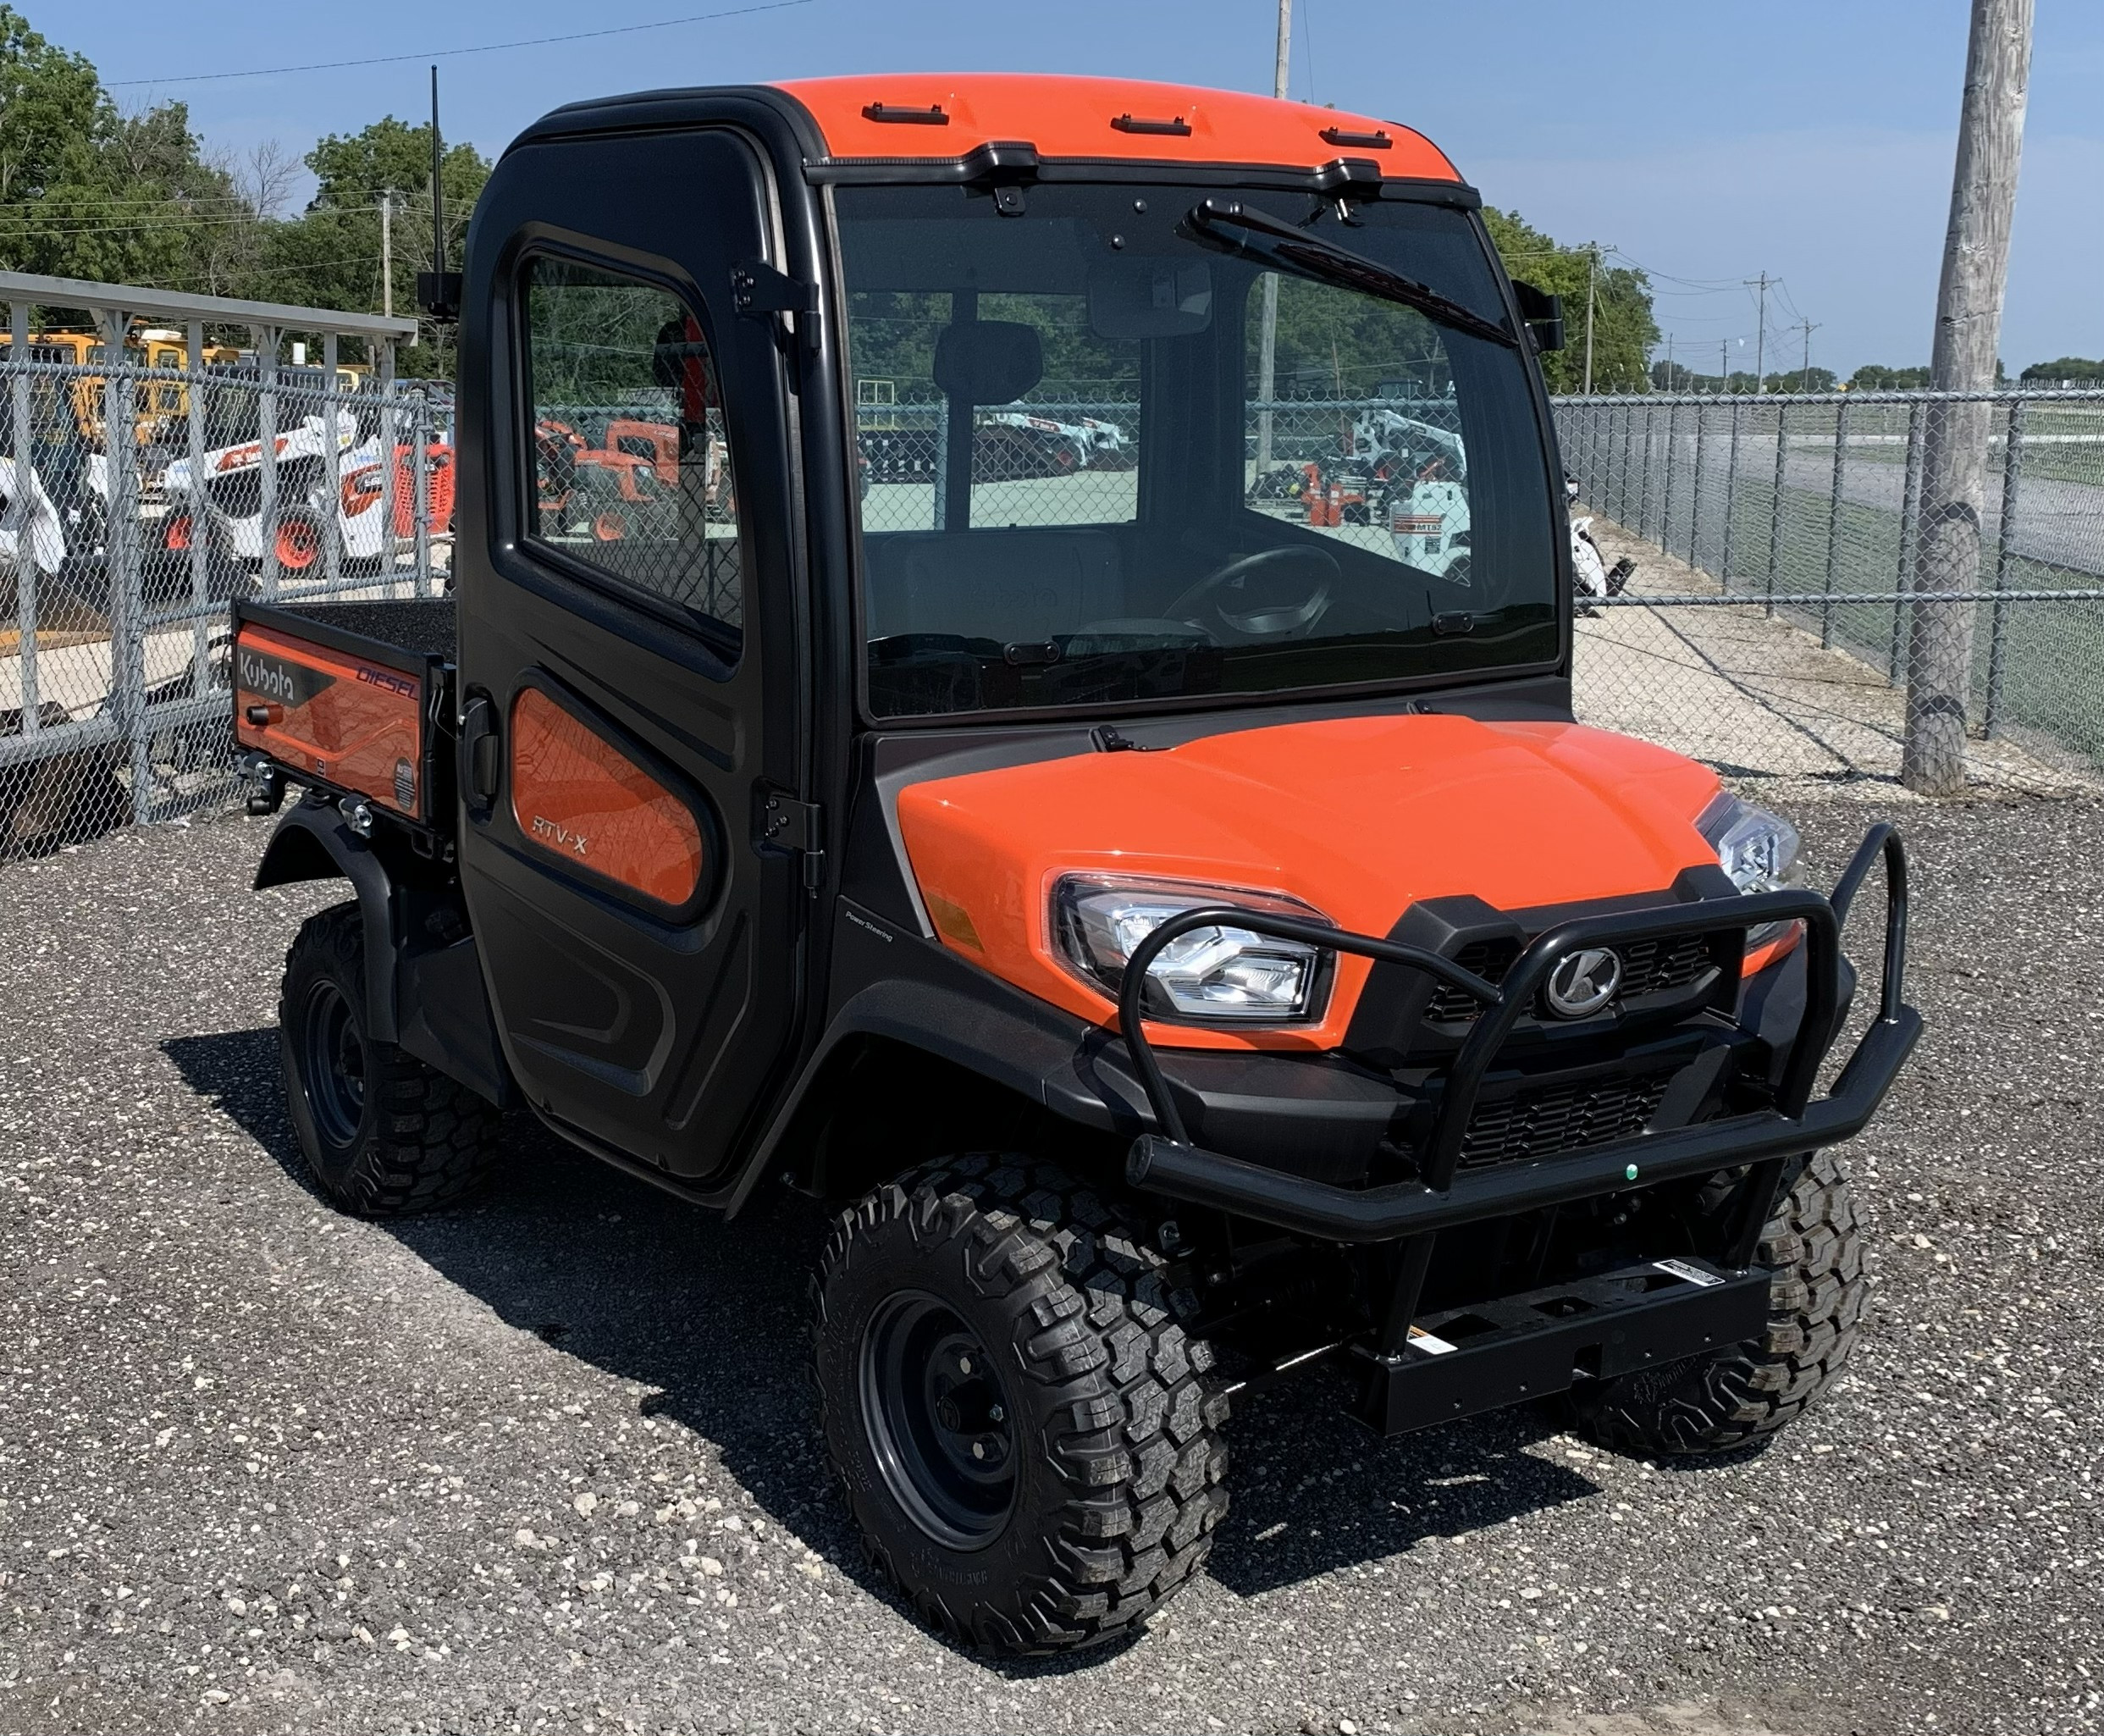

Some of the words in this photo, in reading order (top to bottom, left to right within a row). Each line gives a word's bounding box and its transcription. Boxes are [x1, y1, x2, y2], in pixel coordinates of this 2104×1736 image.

[240, 652, 294, 700] Kubota
[356, 666, 418, 701] DIESEL
[533, 815, 588, 854] RTV-X
[846, 910, 865, 926] Power
[864, 921, 893, 943] Steering
